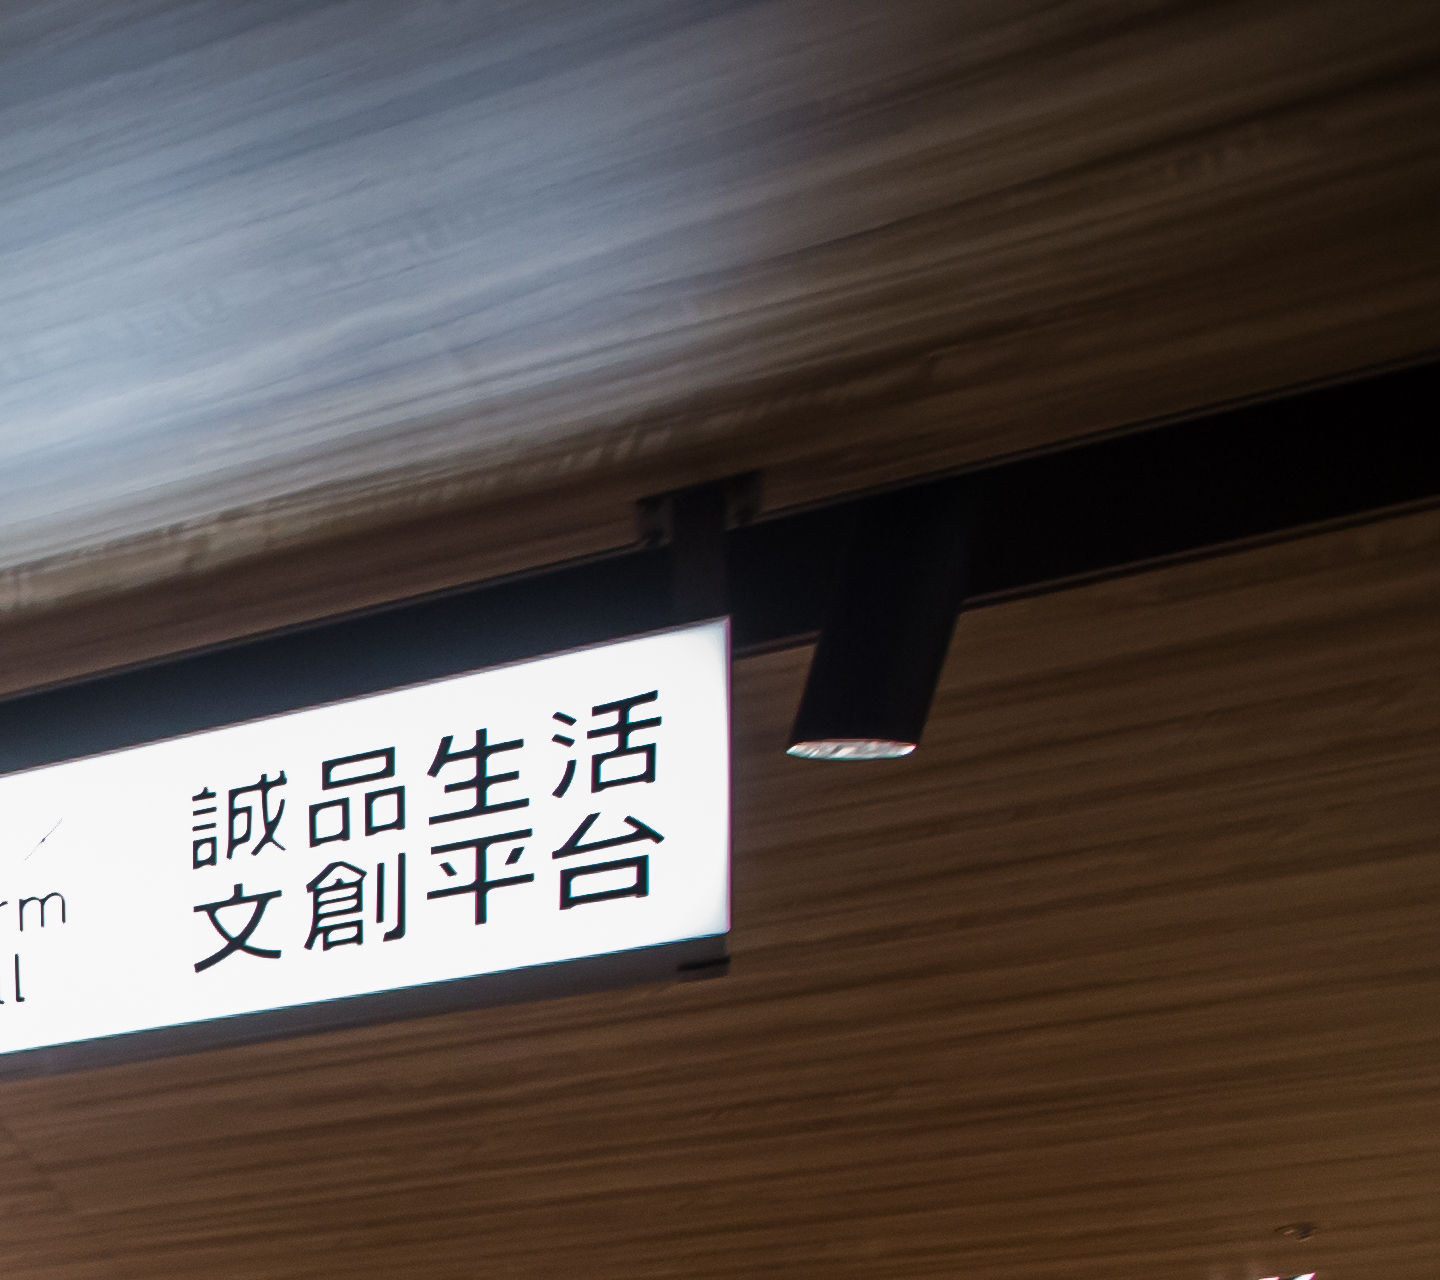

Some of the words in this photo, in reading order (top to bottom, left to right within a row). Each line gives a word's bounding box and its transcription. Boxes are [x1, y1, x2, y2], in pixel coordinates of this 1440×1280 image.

[192, 688, 665, 870] 誠品生活
[193, 811, 665, 974] 文創平台
